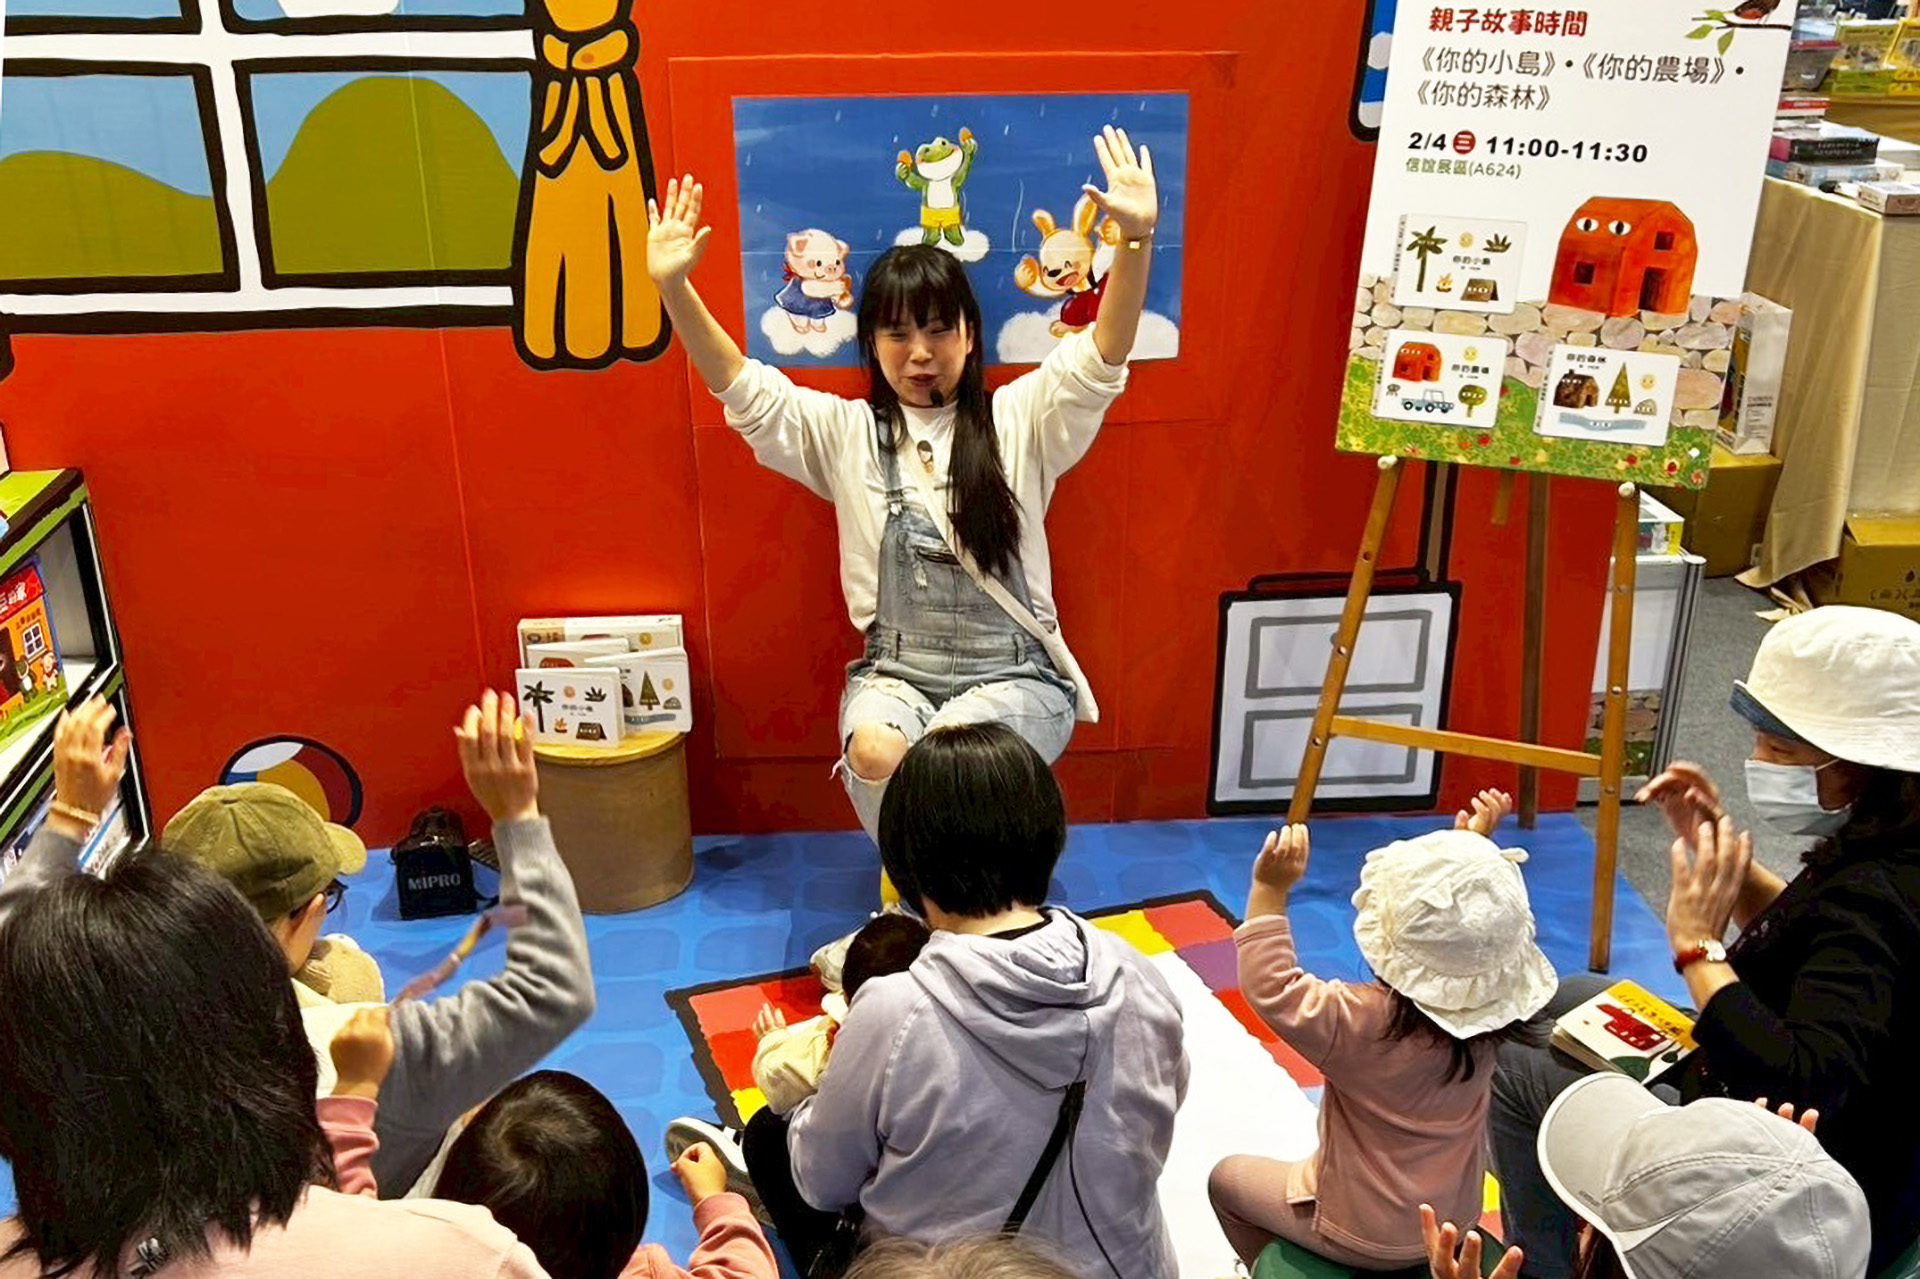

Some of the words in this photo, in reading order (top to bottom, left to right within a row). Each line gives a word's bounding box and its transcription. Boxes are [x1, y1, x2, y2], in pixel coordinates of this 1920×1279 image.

[1429, 7, 1588, 37] 親子故事時間
[1417, 80, 1551, 111] 《你的森林》
[1408, 131, 1447, 151] 2/4
[1486, 136, 1648, 163] 11:00-11:30
[408, 873, 461, 890] MIPRO
